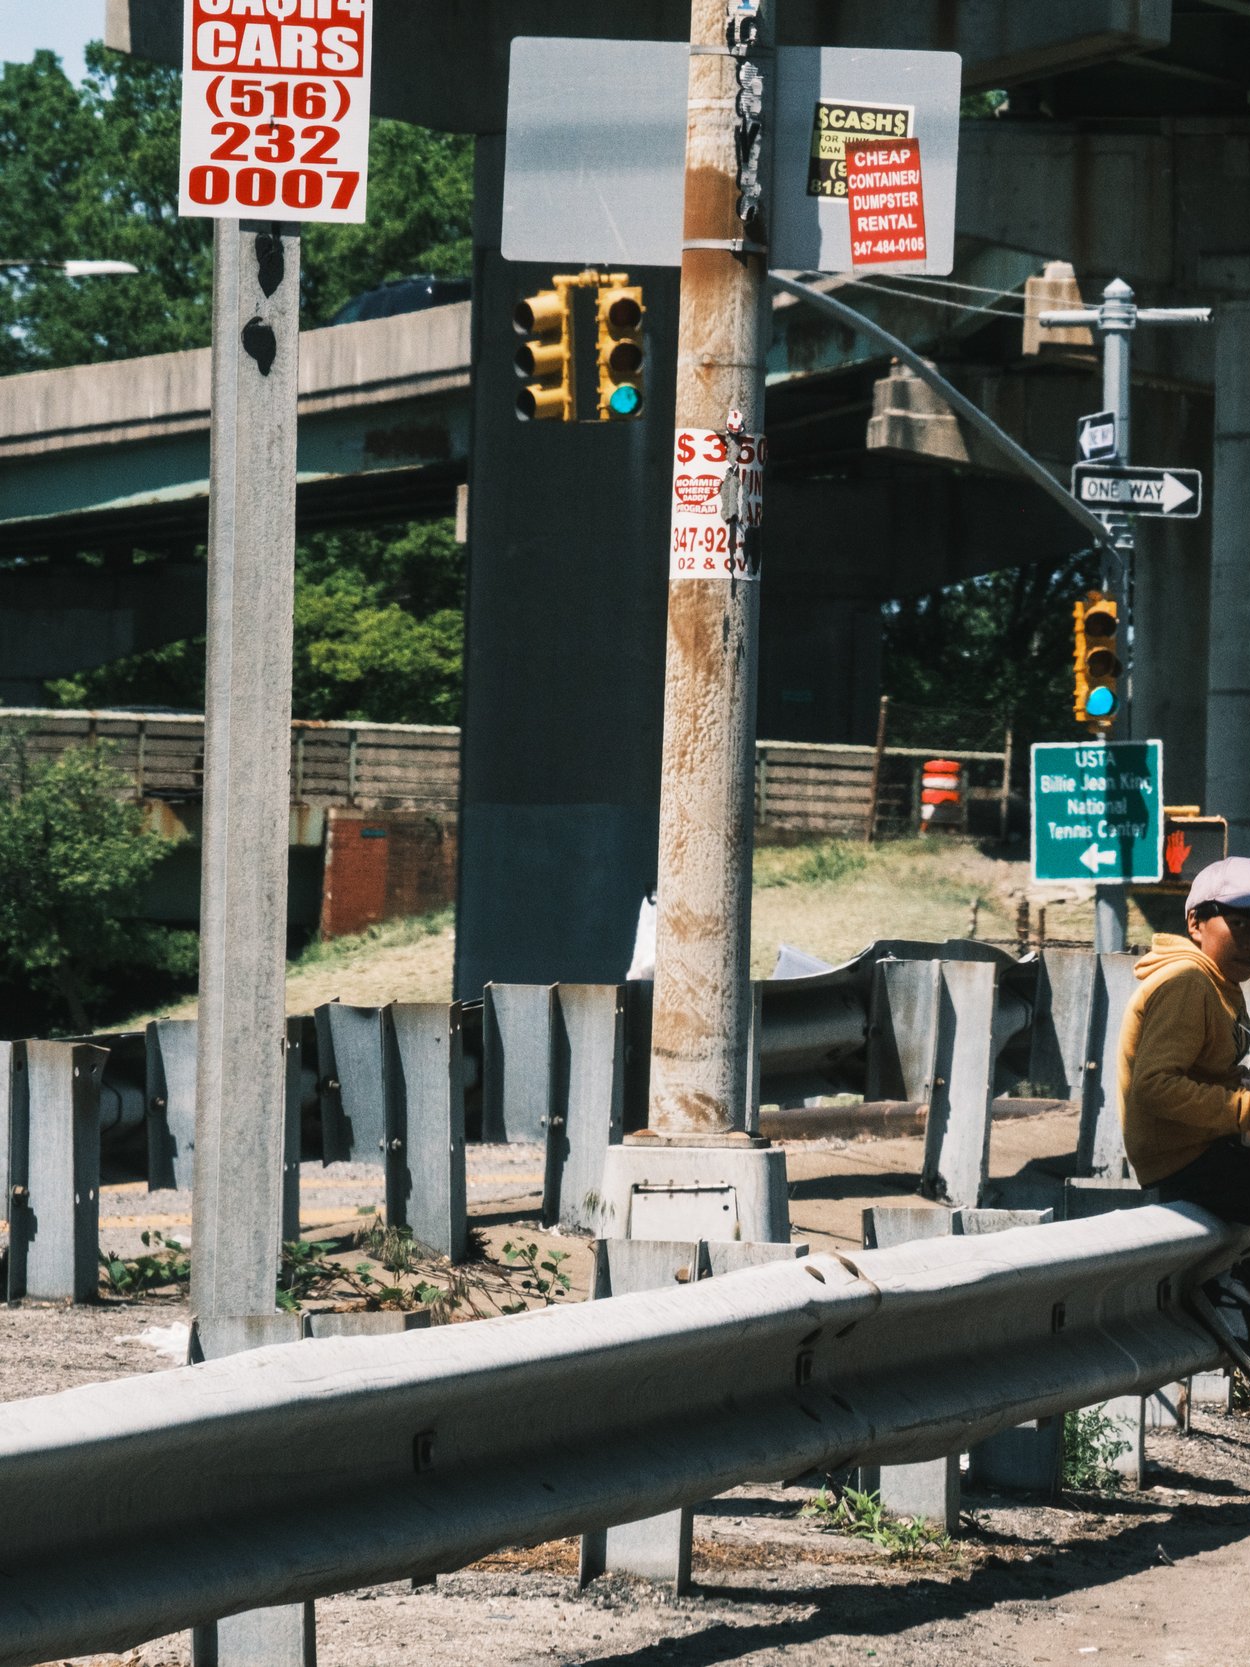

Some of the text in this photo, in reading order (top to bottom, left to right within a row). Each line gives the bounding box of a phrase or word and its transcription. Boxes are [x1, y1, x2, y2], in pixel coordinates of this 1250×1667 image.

[197, 20, 360, 72] CARS
[205, 75, 351, 122] (516)
[819, 106, 906, 137] $CASH$
[210, 121, 341, 165] 232
[819, 134, 839, 143] FOR
[820, 145, 841, 154] VAN
[854, 149, 911, 167] CHEAP
[188, 165, 360, 210] 0007
[850, 169, 920, 189] CONTAINER/
[853, 191, 919, 211] DUMPSTER
[857, 213, 918, 232] RENTAL
[853, 236, 925, 256] 347-484-0105
[1087, 481, 1164, 500] ONE WAY
[677, 557, 696, 570] 02
[702, 557, 716, 570] &
[1075, 750, 1116, 768] USTA
[1041, 772, 1153, 795] Billie Jean King
[1067, 798, 1128, 815] National
[1048, 820, 1146, 840] Tennis Center
